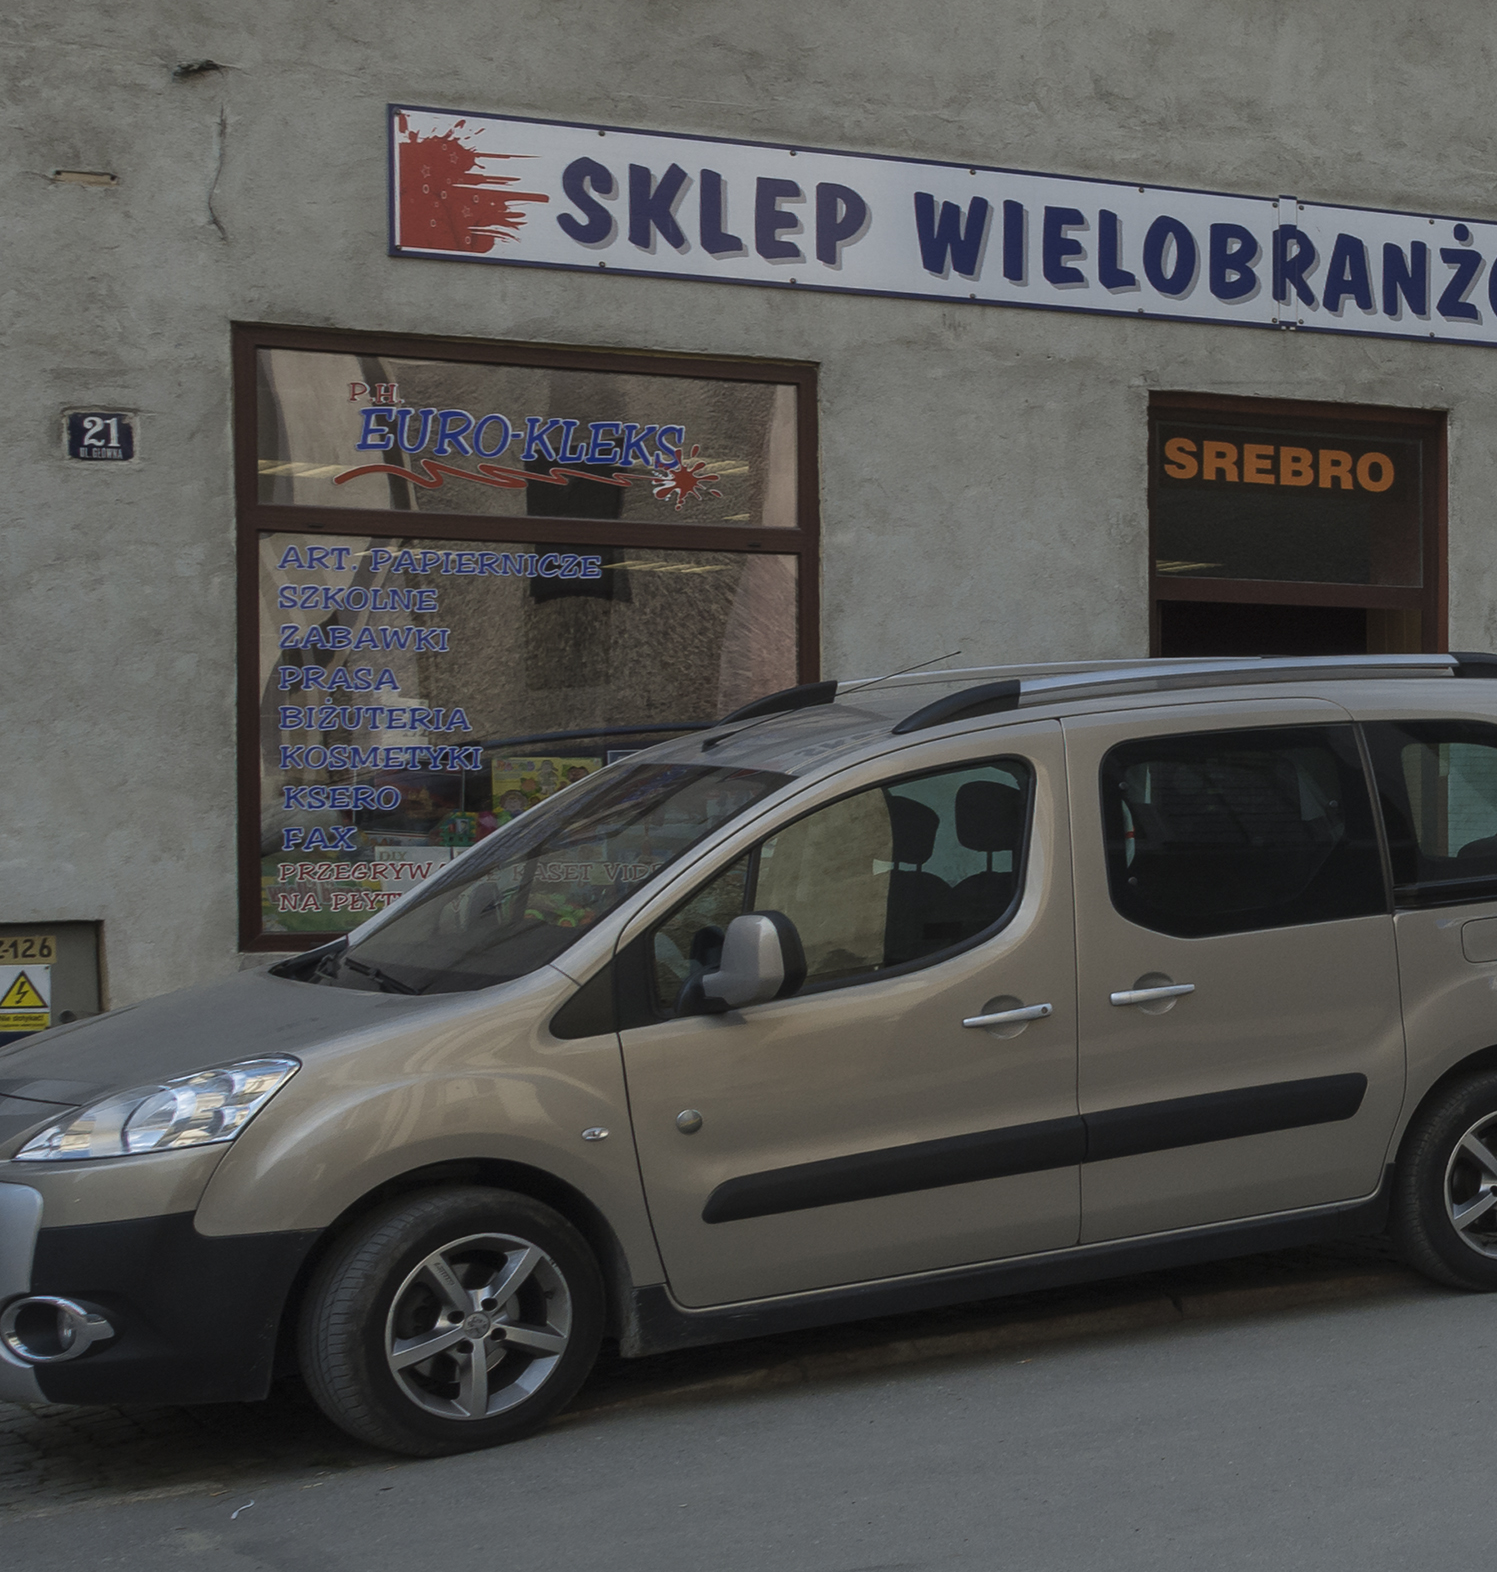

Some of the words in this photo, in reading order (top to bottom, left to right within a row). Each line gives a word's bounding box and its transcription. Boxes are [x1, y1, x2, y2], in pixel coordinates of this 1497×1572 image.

[556, 156, 870, 267] SKLEP
[349, 382, 405, 404] P.H.
[83, 416, 121, 447] 21
[356, 407, 686, 469] EURO-KLEKS
[1163, 437, 1395, 493] SREBRO
[277, 545, 357, 572] ART.
[370, 548, 602, 578] PAPIERNICZE
[278, 584, 439, 613] SZKOLNE
[278, 624, 450, 652] ZABAWKI
[278, 665, 400, 692] PRASA
[278, 697, 472, 731] BIŻUTERIA
[279, 745, 483, 770] KOSMETYKI
[283, 785, 401, 811] KSERO
[281, 826, 357, 851] FAX
[278, 891, 322, 913] NA
